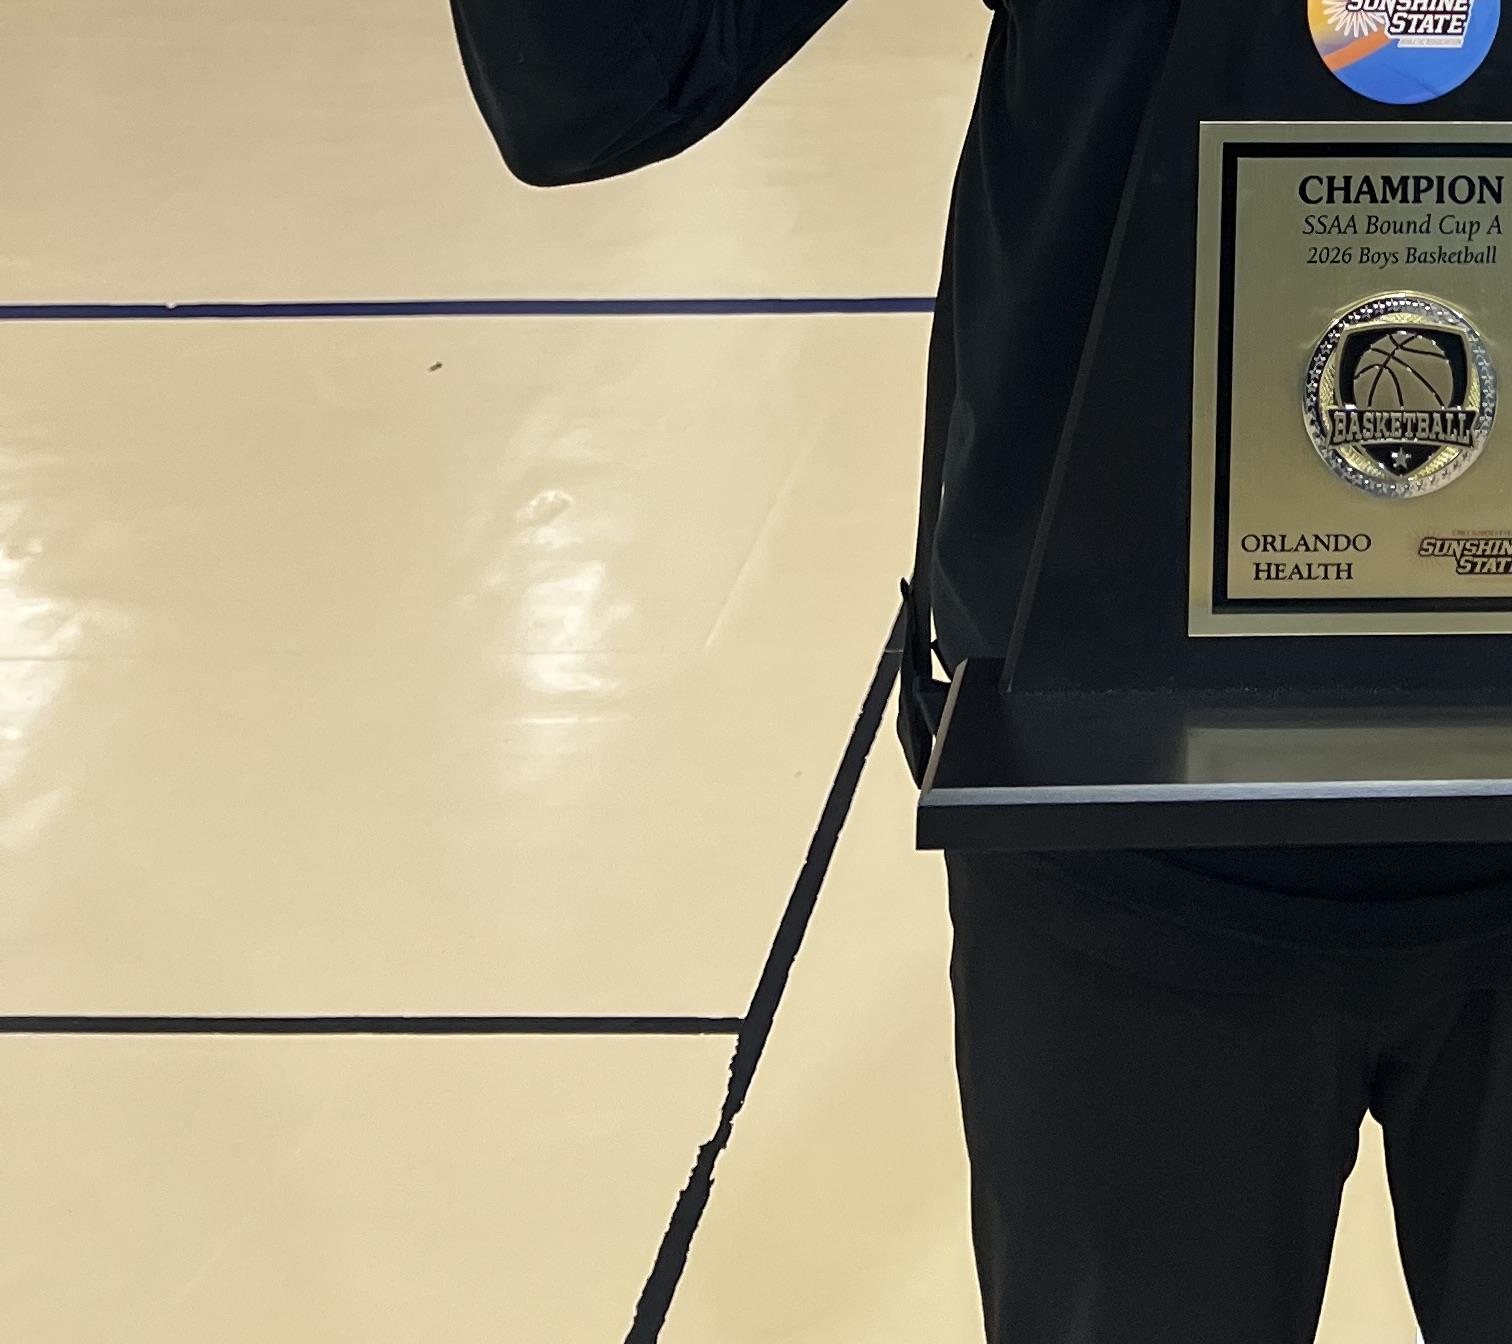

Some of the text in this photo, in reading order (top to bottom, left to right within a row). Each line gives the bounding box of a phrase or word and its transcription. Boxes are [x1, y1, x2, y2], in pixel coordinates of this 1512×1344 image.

[1389, 12, 1467, 34] STATE
[1298, 175, 1504, 205] CHAMPION
[1302, 213, 1503, 241] SSAA Bound Cup A
[1306, 245, 1497, 269] 2026 Boys Basketball
[1333, 411, 1471, 445] BASKETBALL
[1241, 534, 1372, 553] ORLANDO
[1253, 562, 1354, 581] HEALTH
